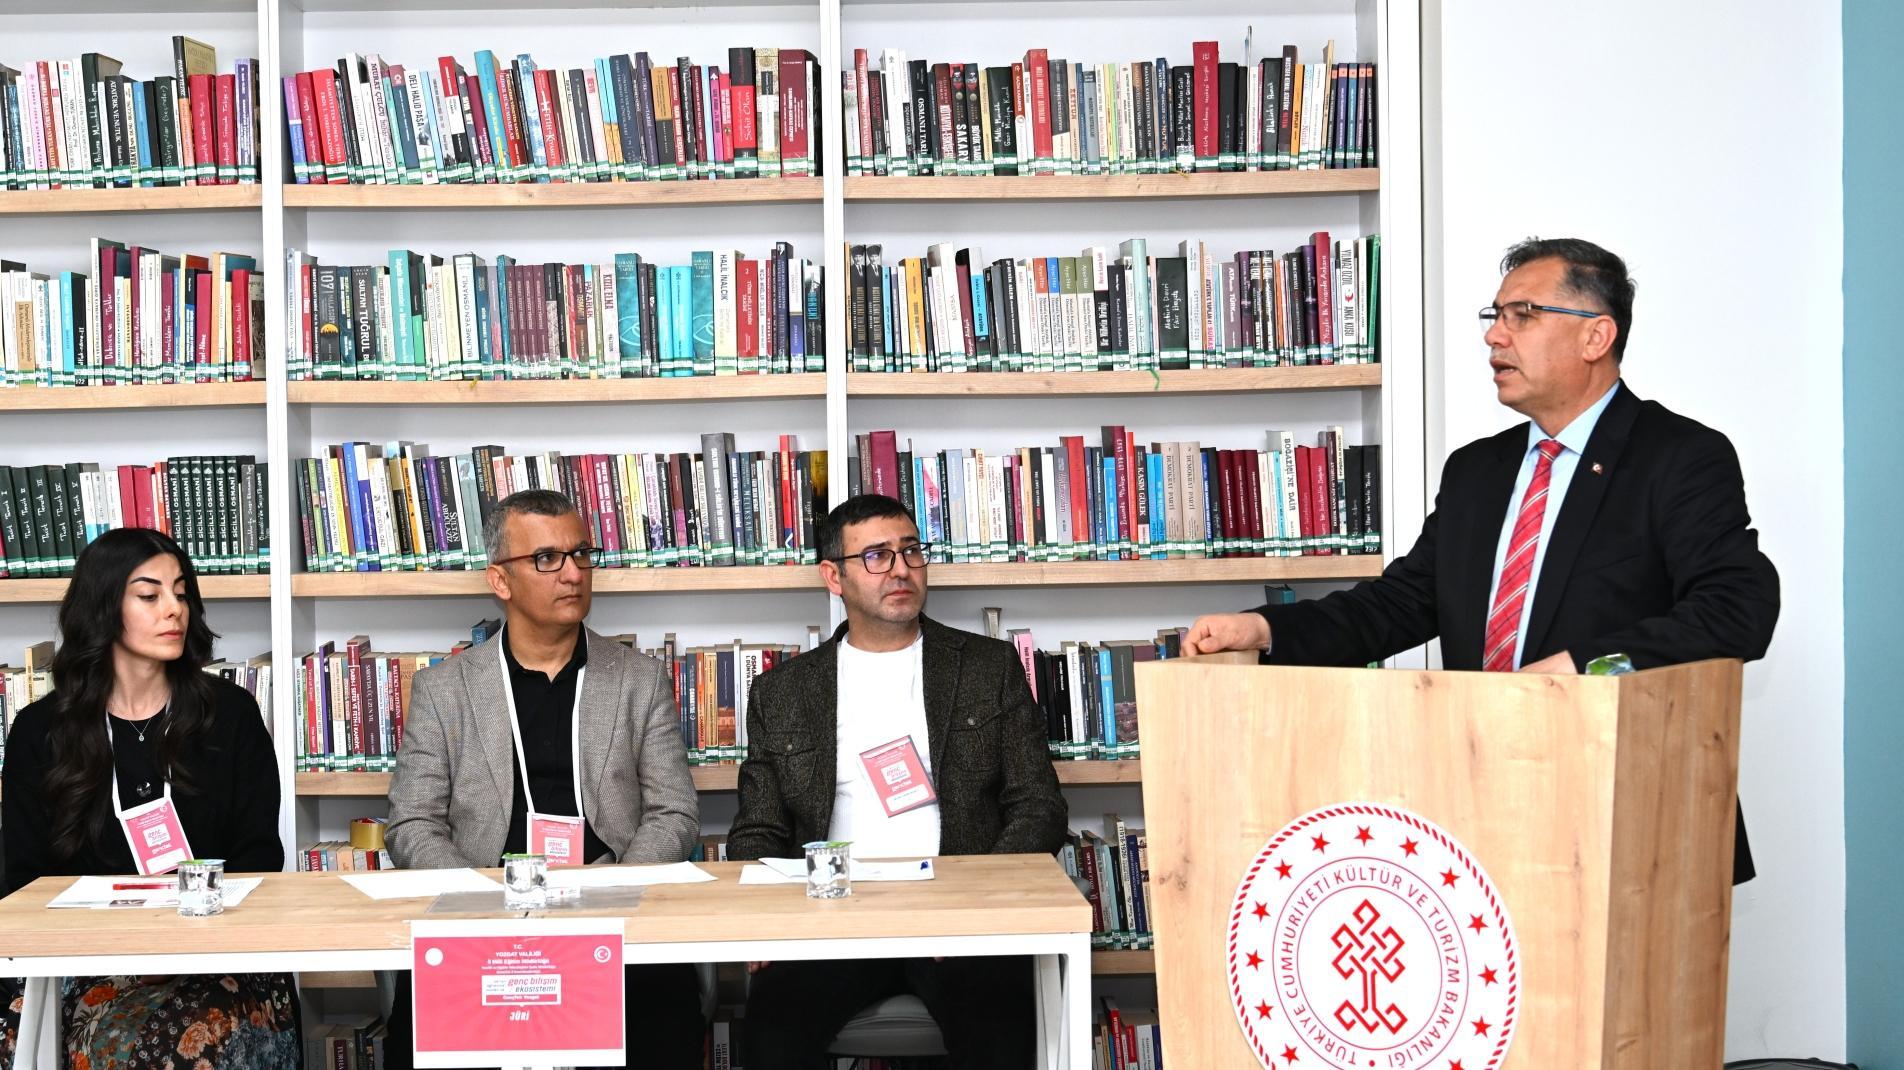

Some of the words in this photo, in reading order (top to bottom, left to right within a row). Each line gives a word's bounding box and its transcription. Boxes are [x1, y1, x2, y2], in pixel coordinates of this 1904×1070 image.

[371, 63, 380, 90] MURAT
[408, 74, 417, 89] DELİ
[110, 80, 120, 109] ATATÜRK
[411, 90, 420, 108] HALİD
[113, 110, 120, 120] VE
[918, 98, 926, 133] OSMANLI
[956, 124, 969, 160] SAKARY
[720, 254, 728, 273] HALİL
[1319, 255, 1327, 280] Ankara
[1341, 250, 1351, 270] YILMAZ
[320, 270, 334, 294] 1071
[358, 279, 366, 308] SULTAN
[462, 275, 470, 311] OSMANLI
[720, 274, 728, 301] İNALCIK
[1344, 306, 1353, 321] ANKA
[359, 310, 370, 353] TUĞRUL
[1138, 492, 1146, 517] GÜLEK
[450, 512, 458, 542] SULTAN
[1333, 864, 1402, 890] KÜLTÜR
[1407, 883, 1428, 907] VE
[1281, 874, 1331, 999] CUMHURİYETİ
[1427, 906, 1460, 984] TURİZM
[508, 978, 528, 986] genç
[530, 978, 558, 986] bilişim
[1293, 1004, 1356, 1065] TÜRKİYE
[1387, 991, 1458, 1067] BAKANLIĞI
